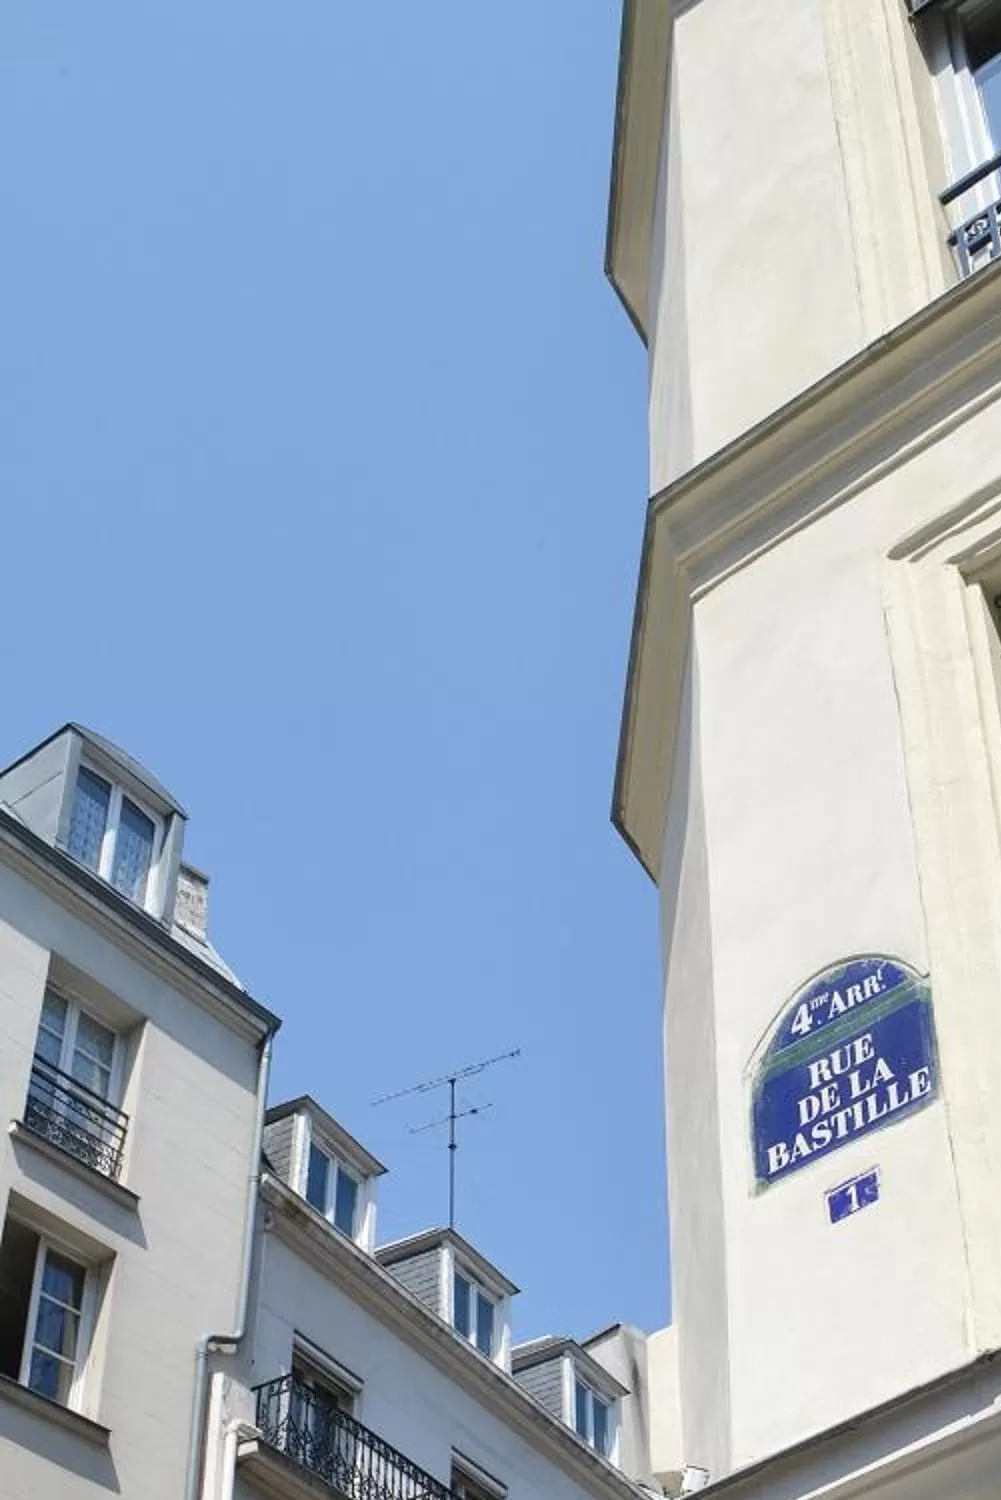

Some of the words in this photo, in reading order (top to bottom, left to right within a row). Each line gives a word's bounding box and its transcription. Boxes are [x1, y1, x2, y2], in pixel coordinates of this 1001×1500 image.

[798, 1083, 841, 1127] DE
[850, 1057, 895, 1100] LA
[808, 1033, 874, 1089] RUE
[767, 1066, 932, 1175] BASTILLE
[845, 1184, 860, 1211] 1
